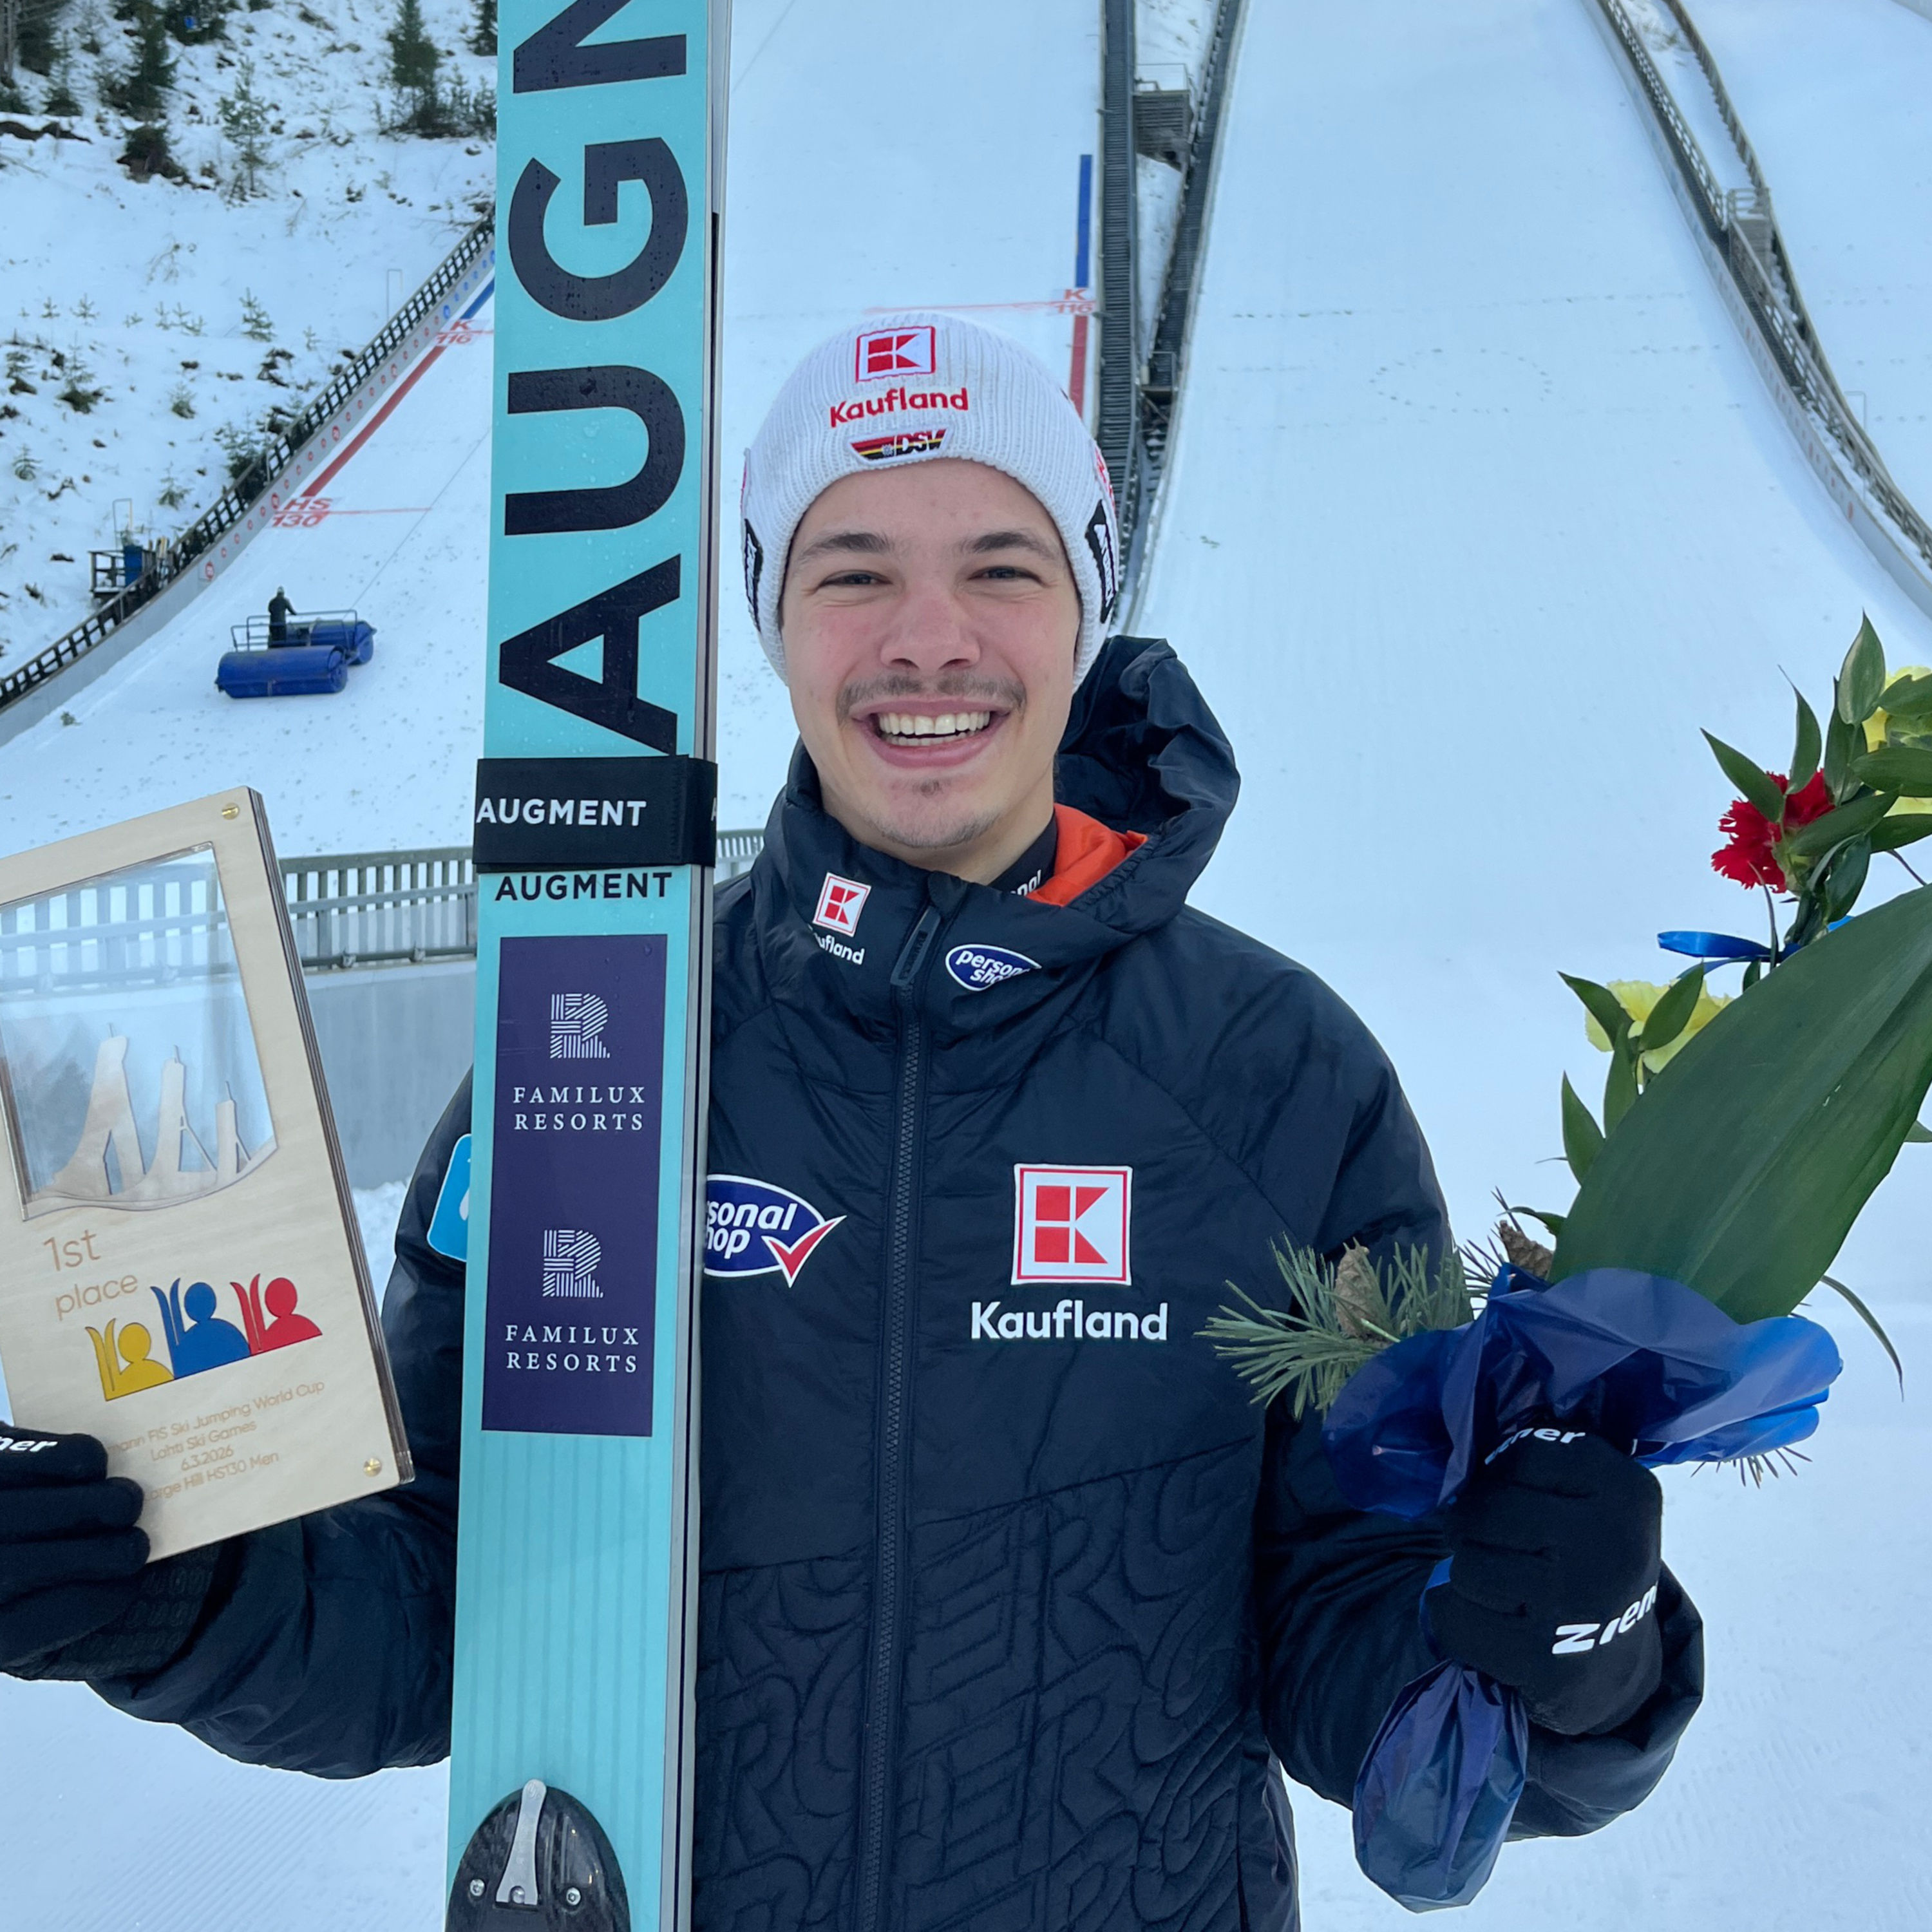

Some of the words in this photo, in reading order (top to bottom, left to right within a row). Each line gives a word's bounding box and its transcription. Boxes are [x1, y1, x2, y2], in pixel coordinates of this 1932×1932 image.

[1065, 289, 1086, 301] K
[450, 319, 475, 330] K
[830, 386, 969, 428] Kaufland
[896, 429, 947, 455] DSV
[284, 498, 333, 510] HS
[272, 514, 324, 527] 130
[476, 798, 647, 826] AUGMENT
[495, 872, 672, 901] AUGMENT
[813, 933, 865, 965] ufland
[956, 951, 1030, 978] person
[513, 1086, 645, 1103] FAMILUX
[514, 1113, 643, 1130] RESORTS
[707, 1200, 798, 1230] sonal
[43, 1229, 100, 1271] 1st
[55, 1274, 138, 1321] place
[971, 1299, 1168, 1341] Kaufland
[506, 1324, 638, 1345] FAMILUX
[507, 1352, 636, 1373] RESORTS
[148, 1427, 167, 1443] FIS
[171, 1419, 190, 1435] Ski
[194, 1404, 251, 1429] Jumping
[253, 1388, 293, 1410] World
[296, 1381, 325, 1397] Cup
[187, 1434, 206, 1450] Ski
[209, 1421, 257, 1443] Games
[181, 1445, 234, 1472] 6.3.2026
[206, 1459, 247, 1481] HS130
[249, 1453, 279, 1469] Men
[1552, 1580, 1658, 1654] Zien
